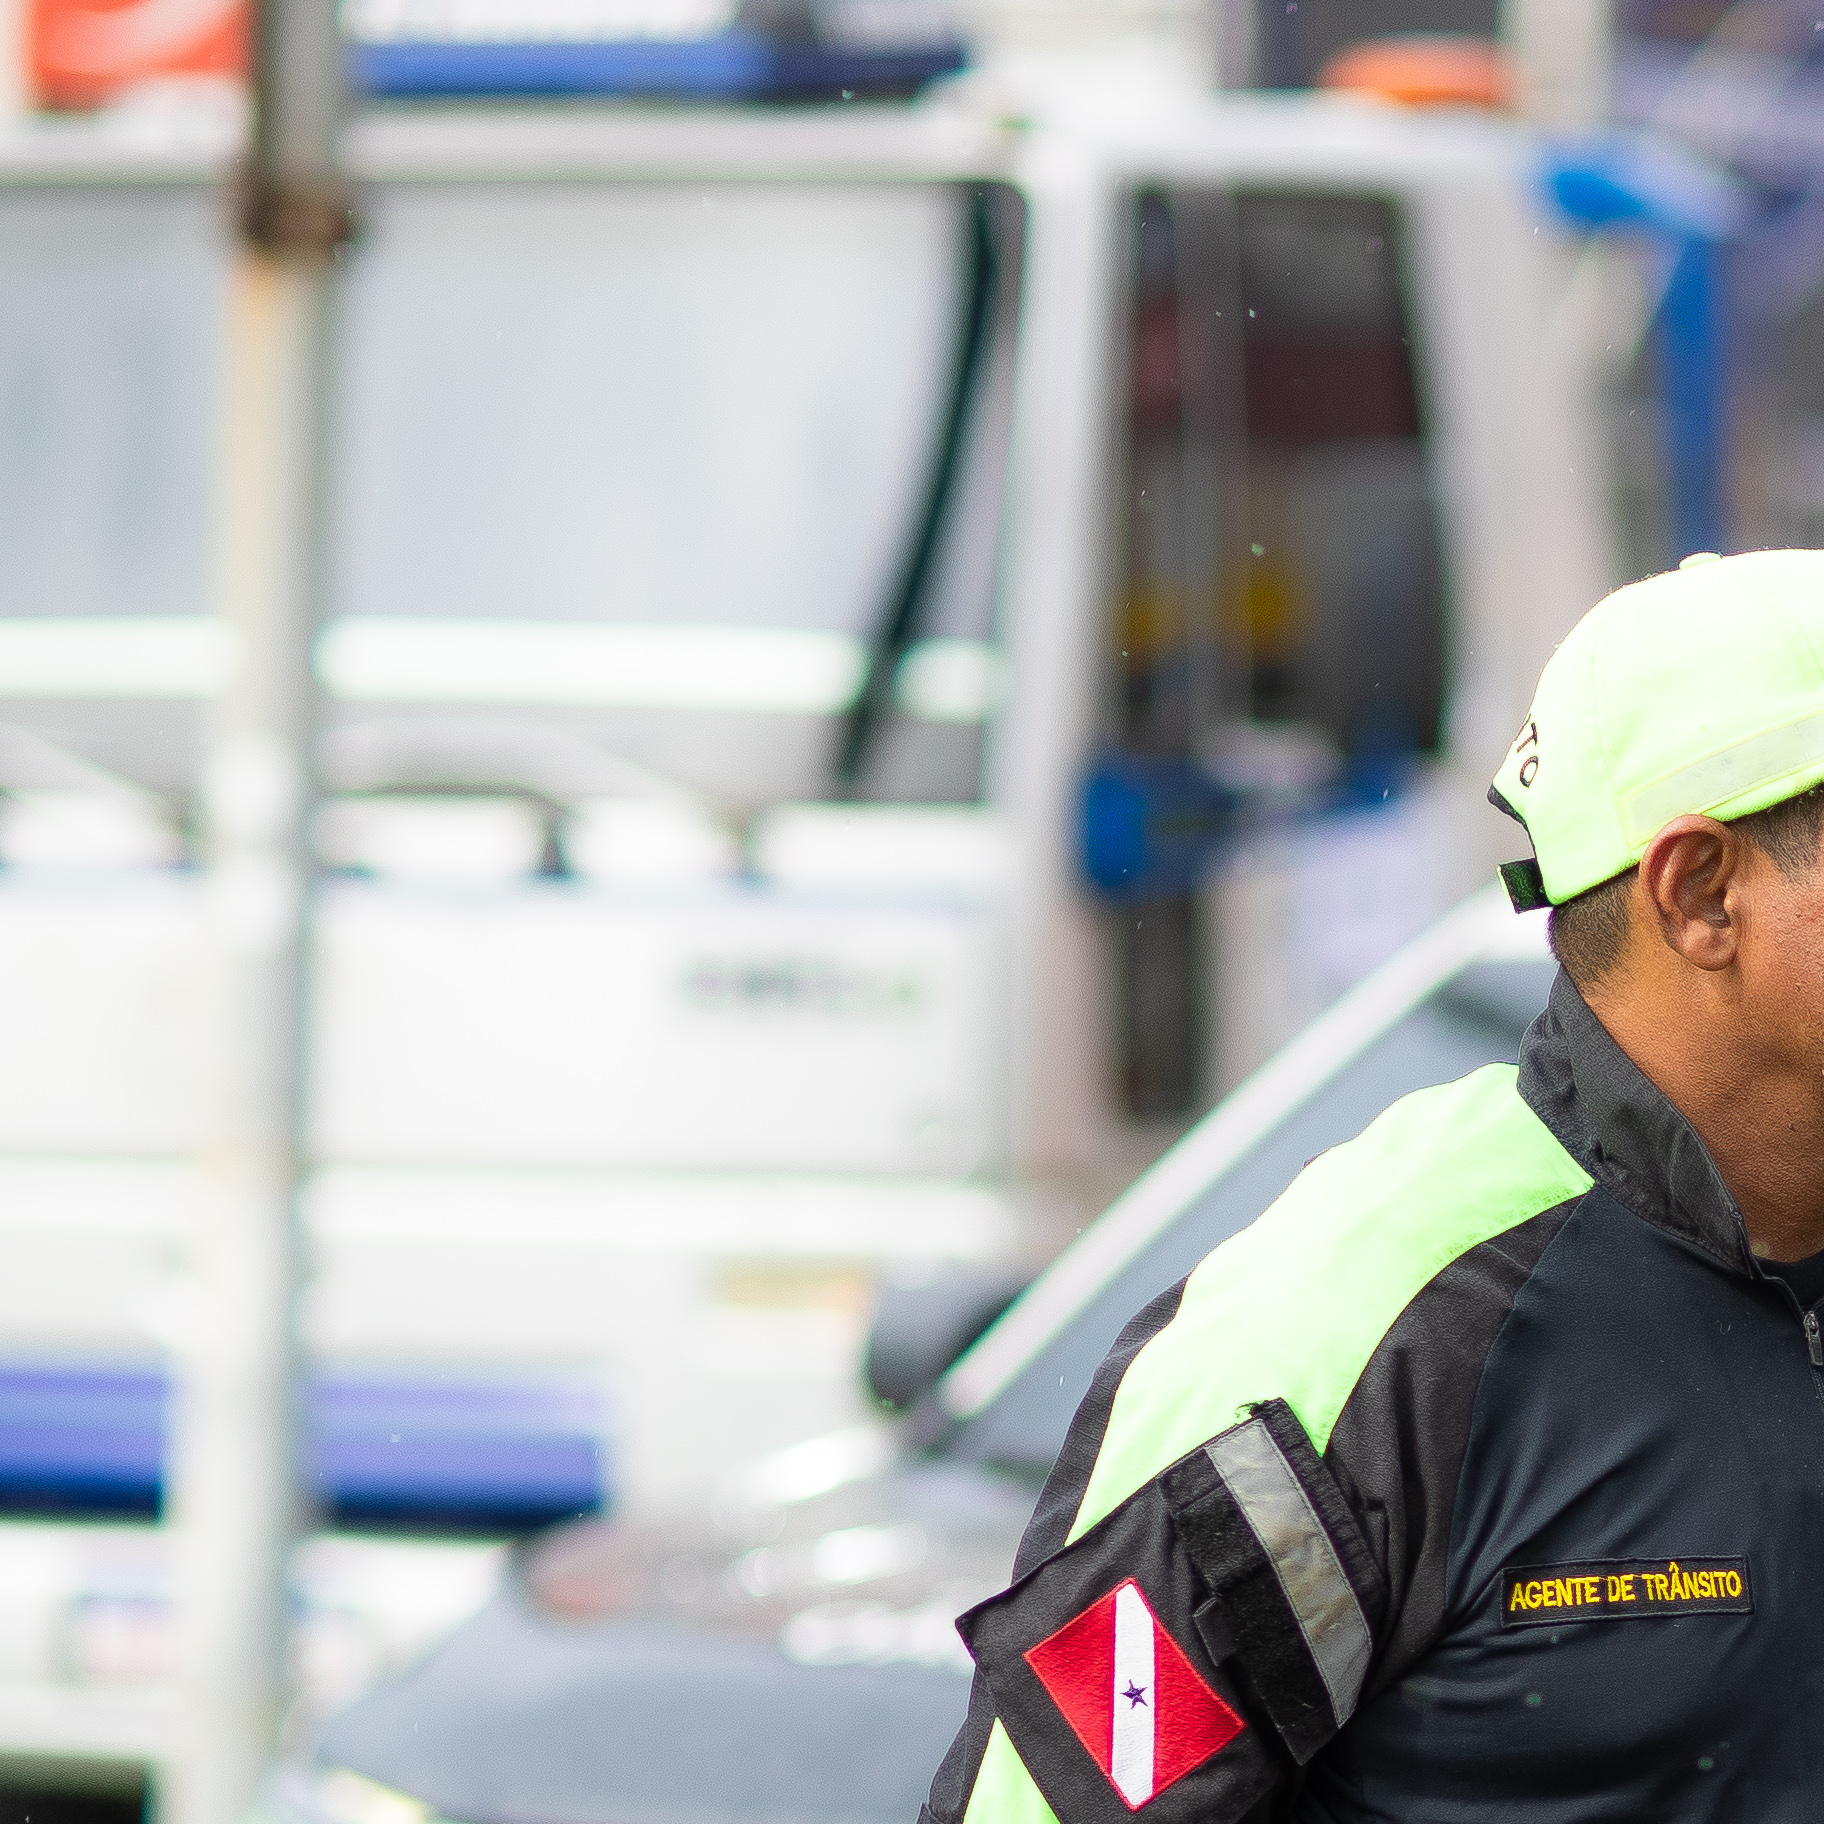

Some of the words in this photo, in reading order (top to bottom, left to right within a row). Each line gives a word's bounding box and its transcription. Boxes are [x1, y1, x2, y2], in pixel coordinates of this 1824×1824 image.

[1510, 1576, 1600, 1611] AGENTE
[1607, 1574, 1635, 1602] DE
[1641, 1561, 1743, 1601] TRÂNSITO
